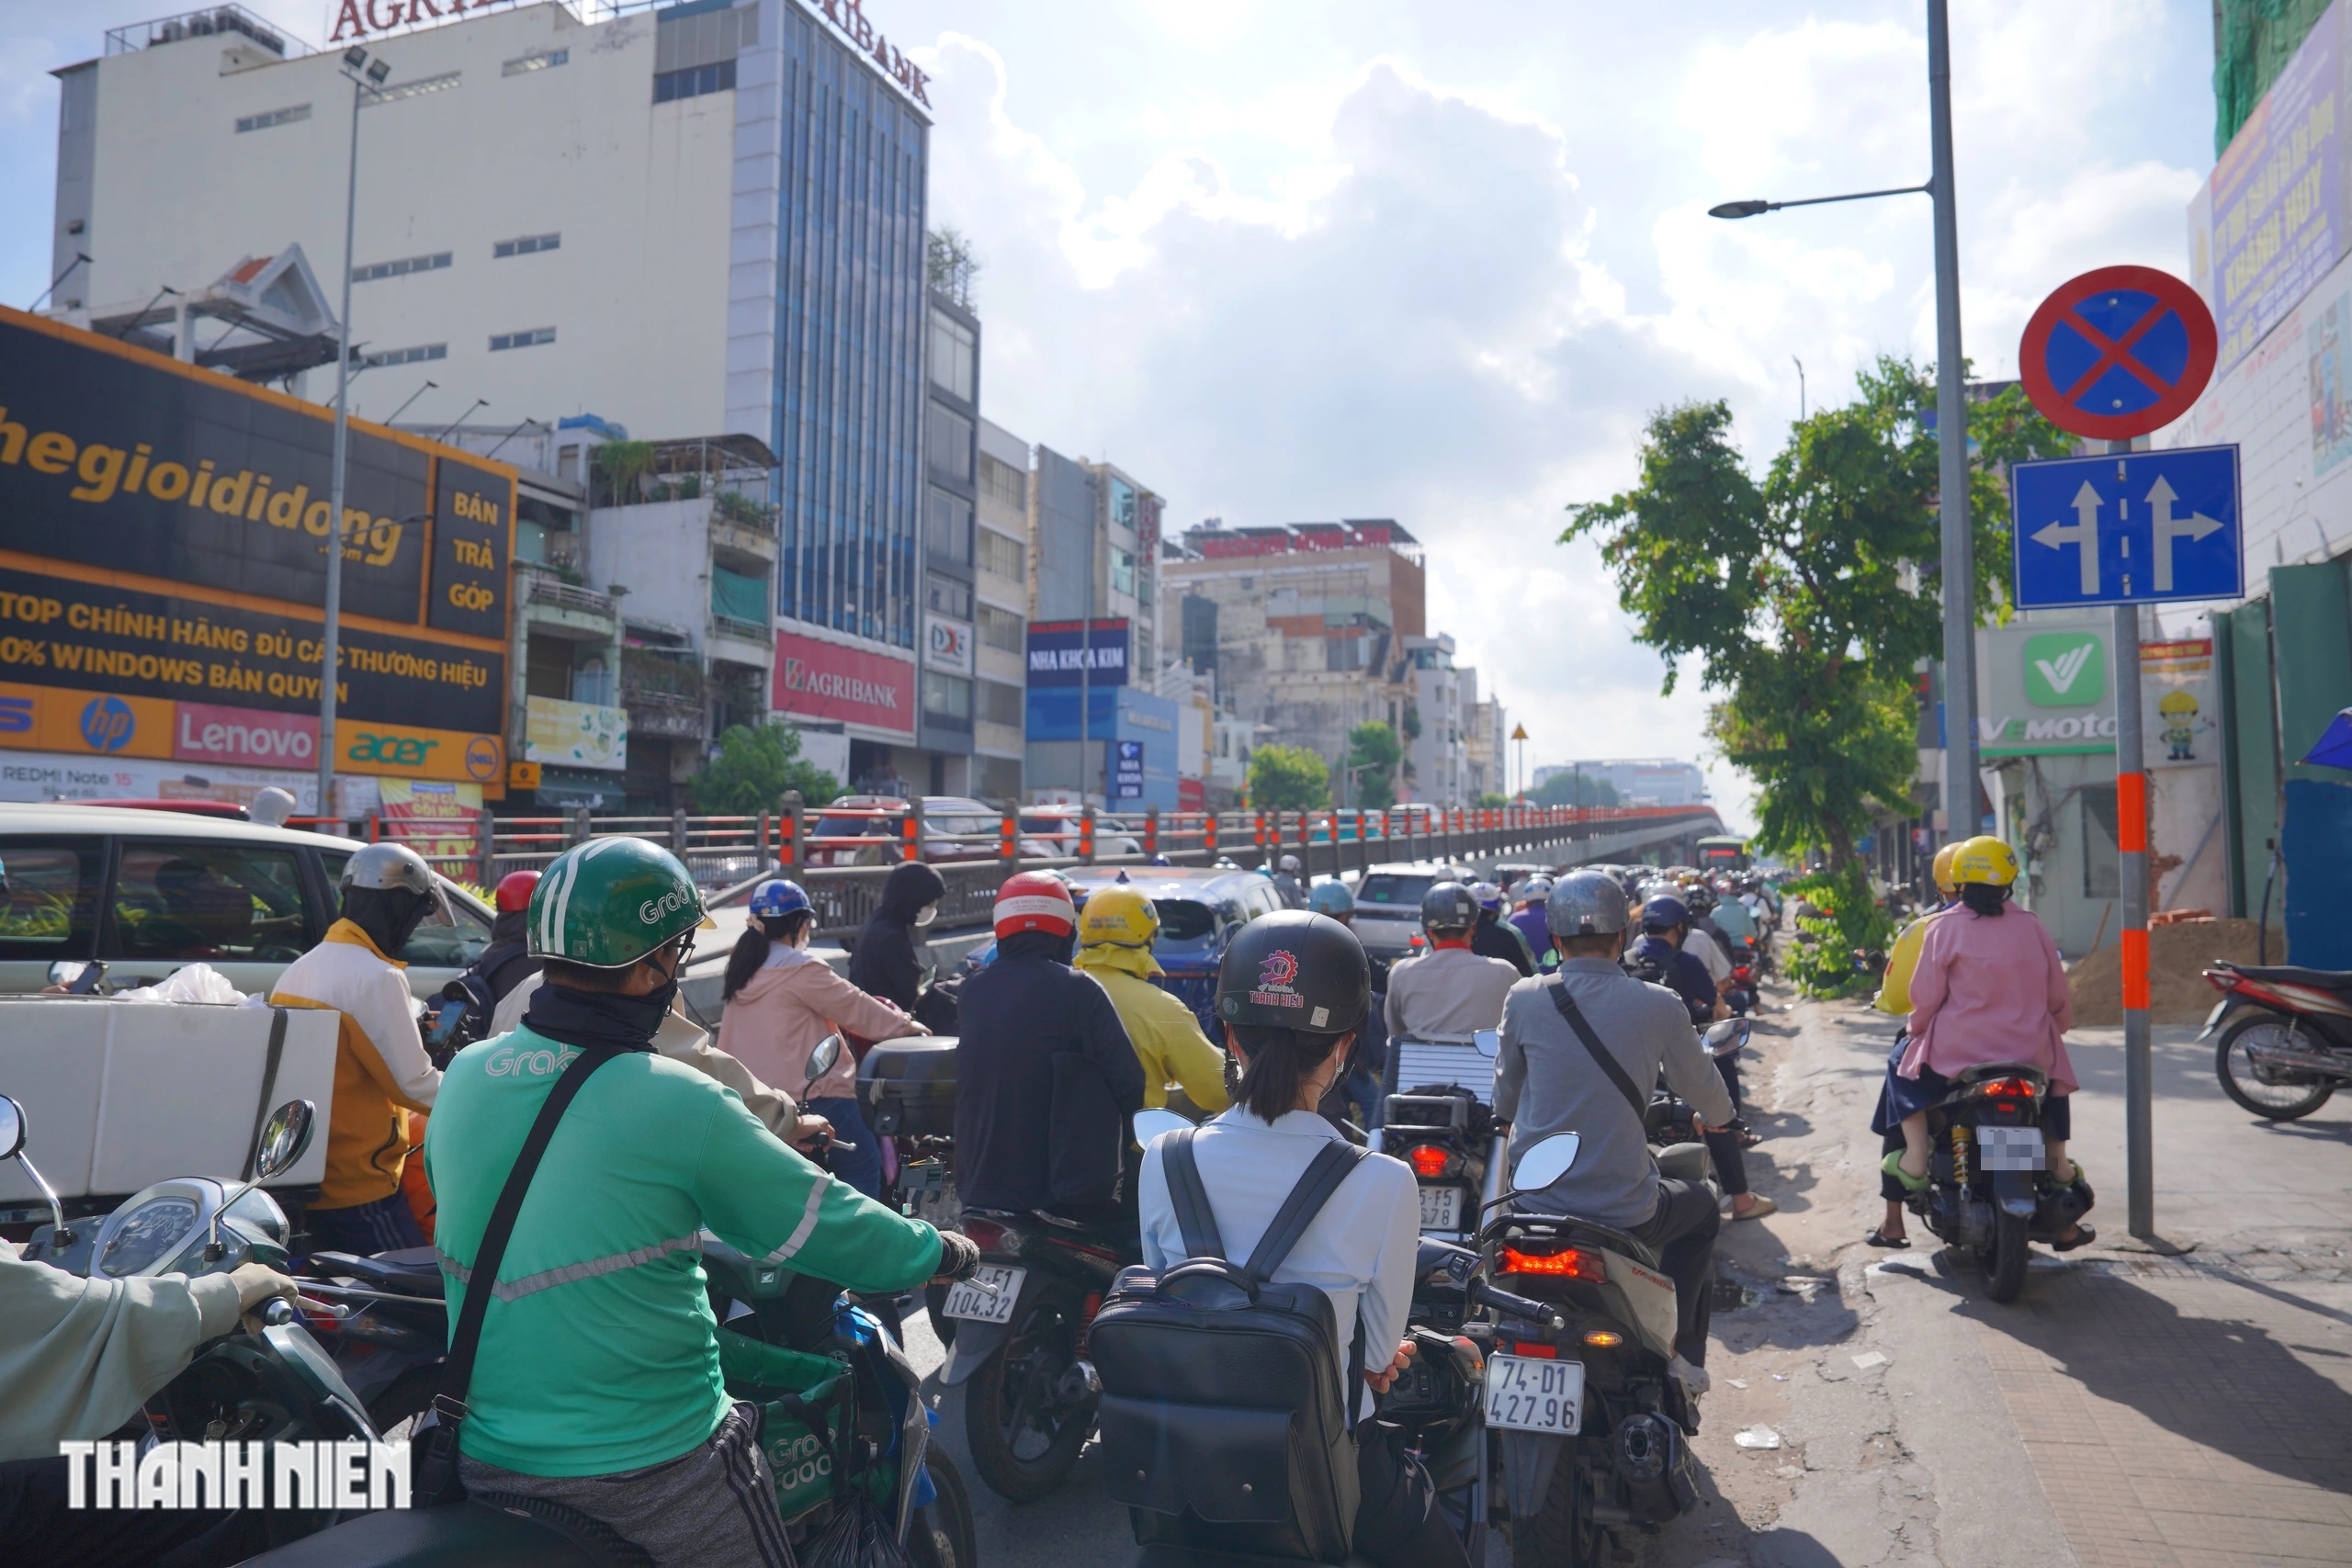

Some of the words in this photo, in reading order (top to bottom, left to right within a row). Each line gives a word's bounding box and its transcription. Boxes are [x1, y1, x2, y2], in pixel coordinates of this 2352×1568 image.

[454, 492, 498, 525] BÁN
[453, 538, 494, 570] TRẢ
[448, 581, 494, 611] GÓP
[67, 603, 167, 641] CHÍNH
[172, 616, 248, 653] HÃNG
[255, 629, 292, 659] ĐỦ
[348, 647, 437, 681] THƯƠNG
[441, 660, 487, 691] HIỆU
[1030, 650, 1057, 671] NHA
[1098, 648, 1124, 668] KIM
[51, 642, 204, 685] WINDOWS
[209, 659, 264, 694] BẢN
[267, 672, 348, 705] QUYN
[806, 671, 897, 708] AGRIBANK
[181, 713, 312, 758] Lenovo
[348, 732, 439, 766] acer
[469, 752, 495, 766] DELL
[3, 766, 62, 783] REDMI
[67, 770, 110, 784] Note
[114, 772, 132, 787] 15
[639, 878, 692, 924] Grab
[1250, 990, 1279, 1007] THANH
[1268, 983, 1295, 994] HONDA
[1077, 1251, 1117, 1269] SIRIUS
[951, 1291, 1012, 1320] 104.32
[1501, 1360, 1566, 1395] 74-D1
[1490, 1393, 1577, 1429] 427.96
[768, 1427, 837, 1468] Gra
